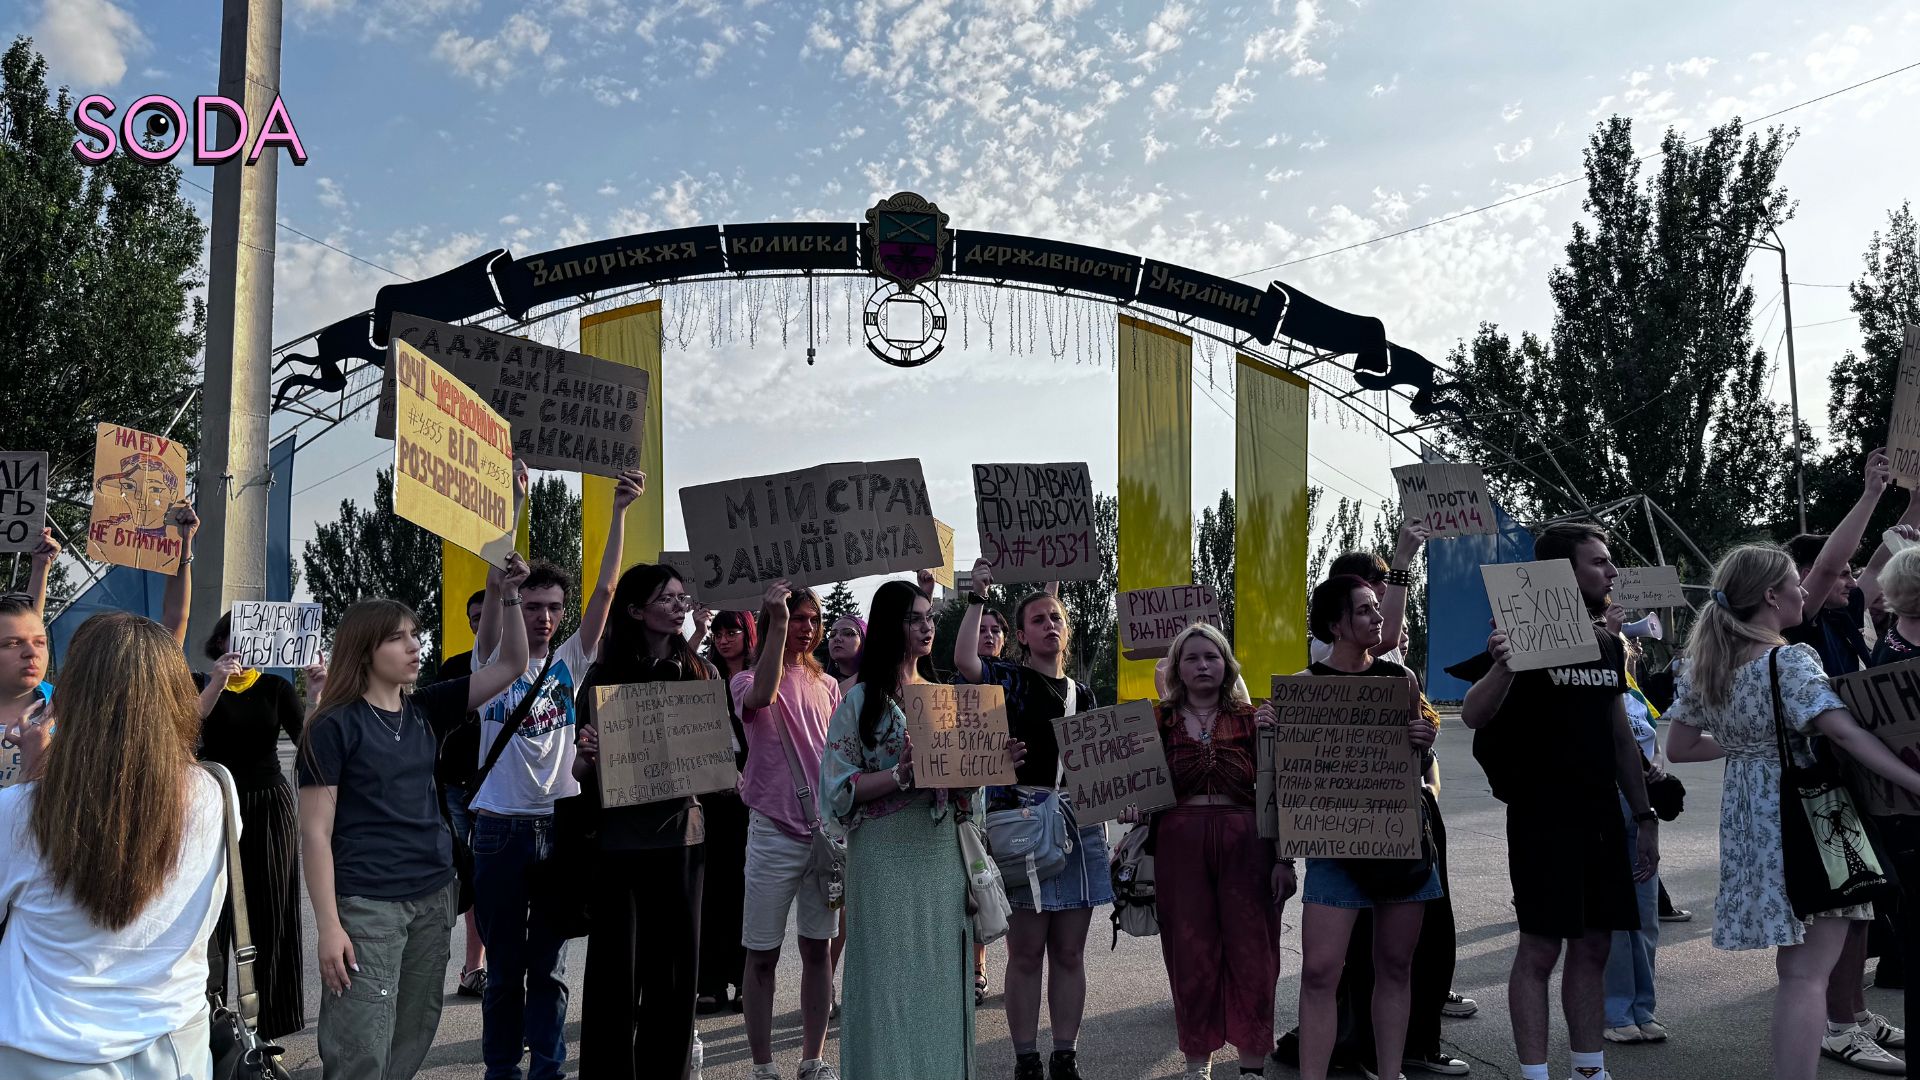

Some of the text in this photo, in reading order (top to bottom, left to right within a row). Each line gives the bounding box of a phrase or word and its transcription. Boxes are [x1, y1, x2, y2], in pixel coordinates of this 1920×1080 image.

[526, 241, 698, 287] Запоріжжя
[732, 235, 848, 254] колиска
[964, 244, 1132, 283] державності
[1150, 267, 1262, 317] України!
[400, 327, 565, 373] САДЖАТИ
[400, 351, 426, 400] ОЧІ
[501, 368, 638, 412] ШКІДНИКІВ
[431, 369, 512, 460] ЧЕРВОНІЮТЬ
[491, 388, 633, 433] НЕ СИЛЬНО
[115, 427, 170, 456] НАБУ
[514, 427, 638, 470] ДИКАЛЬНО
[401, 435, 506, 529] РОЗЧАРУВАННЯ
[976, 464, 1088, 499] ВРУ ДАВАЙ
[1402, 476, 1427, 494] МИ
[724, 473, 932, 529] МІЙ СТРАХ
[1427, 490, 1479, 509] ПРОТИ
[801, 519, 838, 536] ЦЕ
[1425, 508, 1482, 531] 12414
[90, 523, 182, 556] НЕ ВТРАТИМ
[704, 523, 923, 589] ЗАШИТІ ВУСТА
[1516, 567, 1531, 589] Я
[1128, 586, 1212, 616] РУКИ ГЕТЬ
[1498, 587, 1580, 627] НЕ ХОЧУ
[232, 603, 321, 633] НЕЗАЛЕЖНІСТЬ
[233, 636, 272, 665] НАБУ
[281, 635, 317, 665] САП
[1506, 620, 1583, 653] КОРУПЦІЇ
[1275, 683, 1395, 702] ДЯКУЮЧИ ДОЛІ
[932, 731, 953, 749] ЯК
[1062, 711, 1118, 745] 13531
[1324, 728, 1343, 743] МИ
[930, 753, 951, 776] НЕ
[1281, 758, 1311, 774] ХАТА
[1371, 760, 1408, 775] КРАЮ
[1074, 765, 1167, 811] ДЛИВІСТЬ
[1329, 777, 1405, 790] РОЗКИДАЮТЬ
